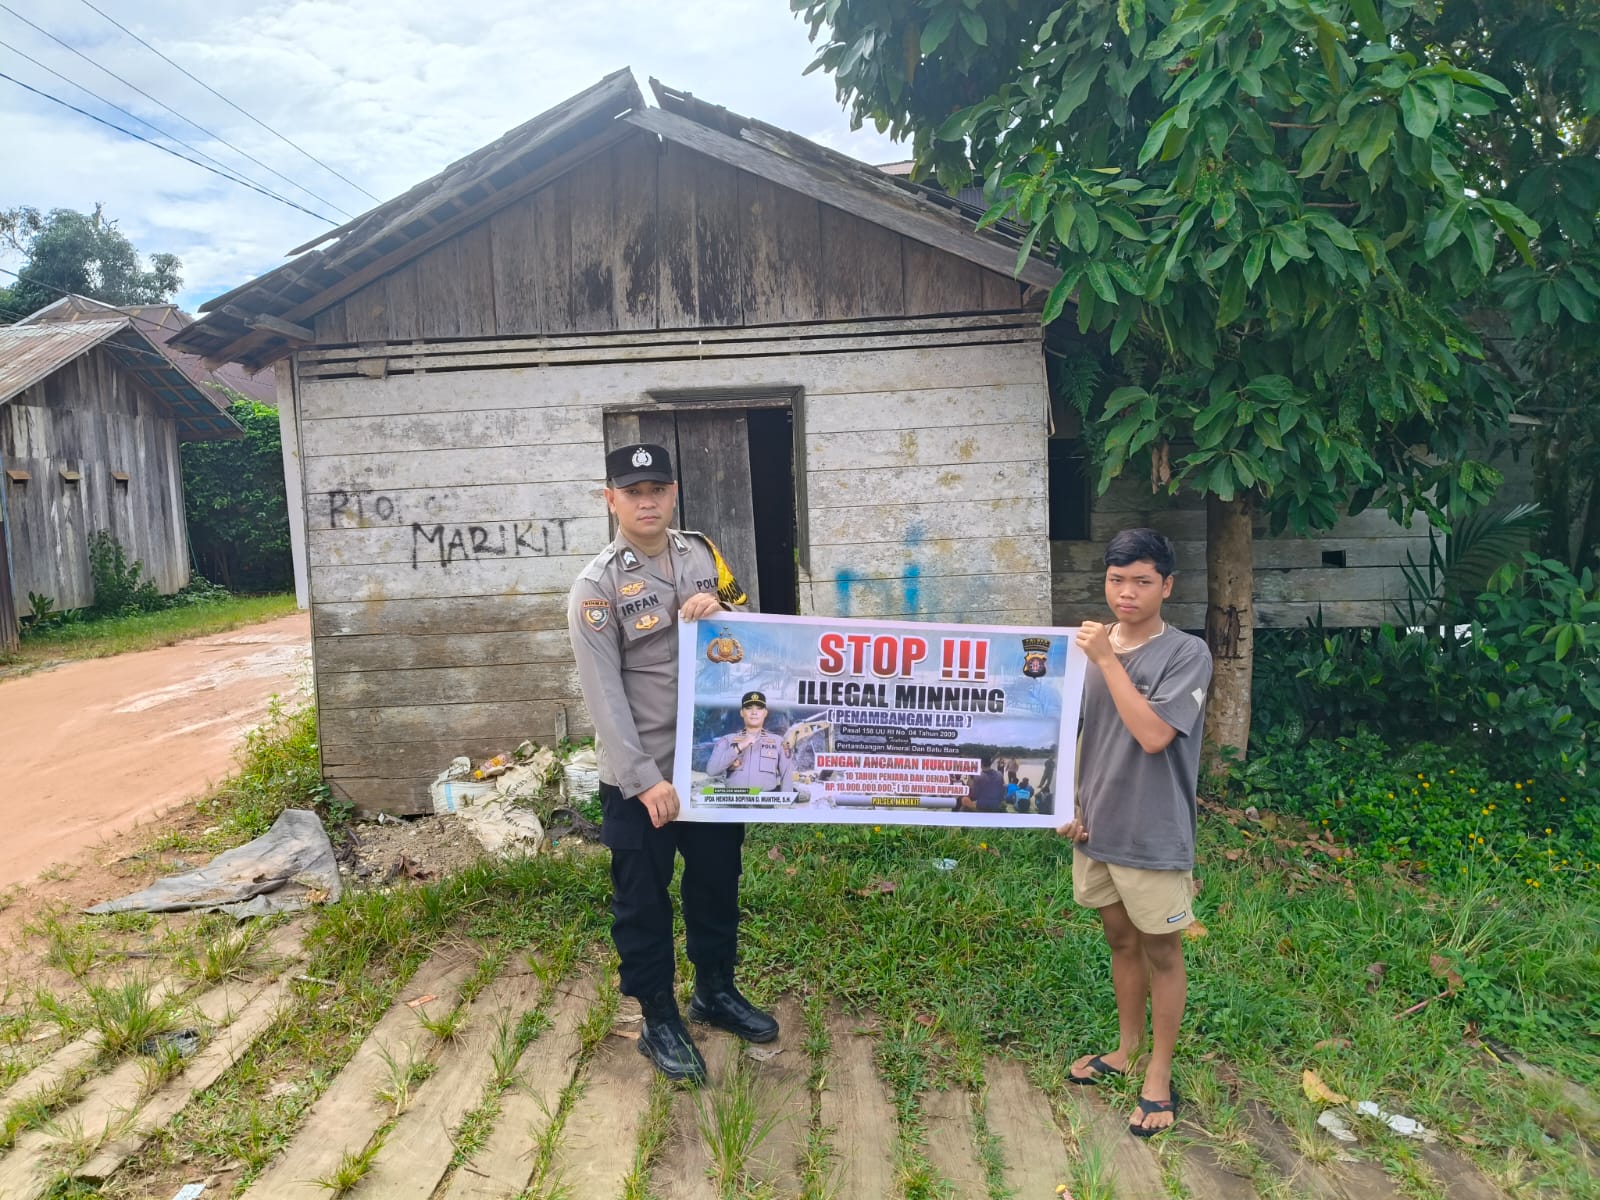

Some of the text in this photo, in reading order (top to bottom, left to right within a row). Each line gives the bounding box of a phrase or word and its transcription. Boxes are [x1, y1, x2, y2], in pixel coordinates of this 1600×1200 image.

[410, 516, 577, 570] MARIKIT
[620, 594, 660, 617] IRFAN
[818, 633, 988, 681] STOP !!!
[797, 680, 1005, 713] ILLEGAL MINNING
[836, 710, 932, 727] PENAMBANGAN
[935, 714, 964, 728] LIAR
[842, 726, 861, 734] Pasal
[837, 742, 885, 752] Pertambangan
[817, 755, 979, 772] DENGAN ANCAMAN HUKUMAN
